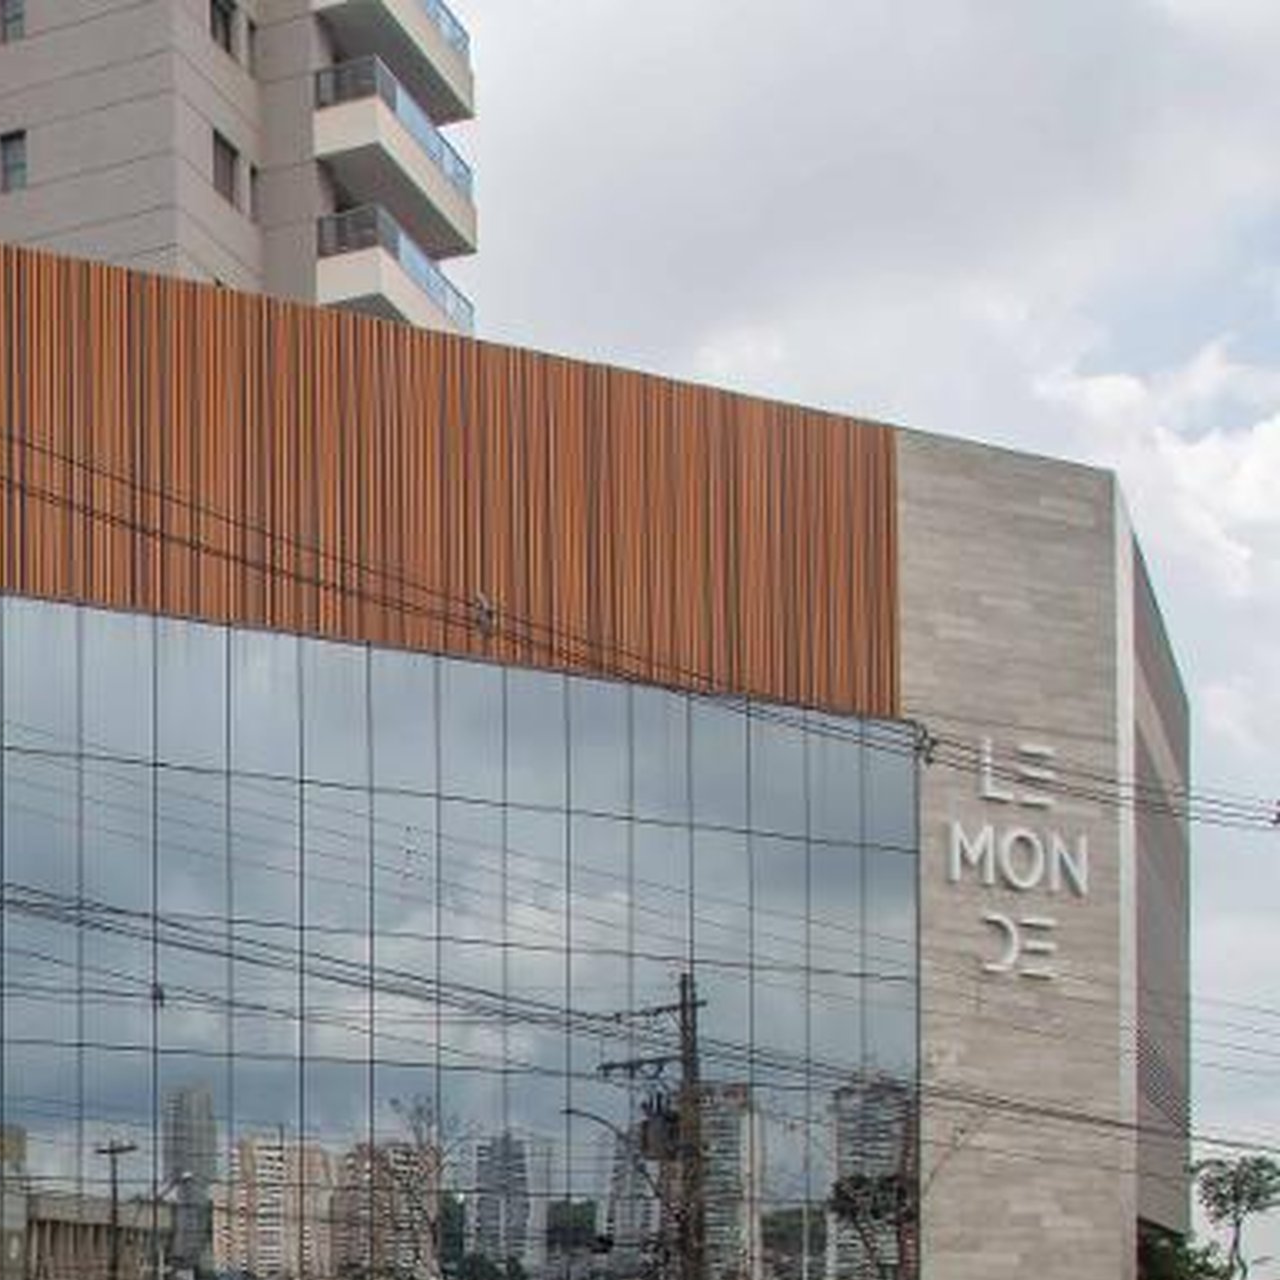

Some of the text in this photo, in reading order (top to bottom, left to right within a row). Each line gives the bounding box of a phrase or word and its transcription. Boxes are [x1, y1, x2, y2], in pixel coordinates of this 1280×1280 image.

[980, 738, 1056, 809] LE
[948, 821, 1089, 898] MON
[983, 914, 1057, 979] DE
